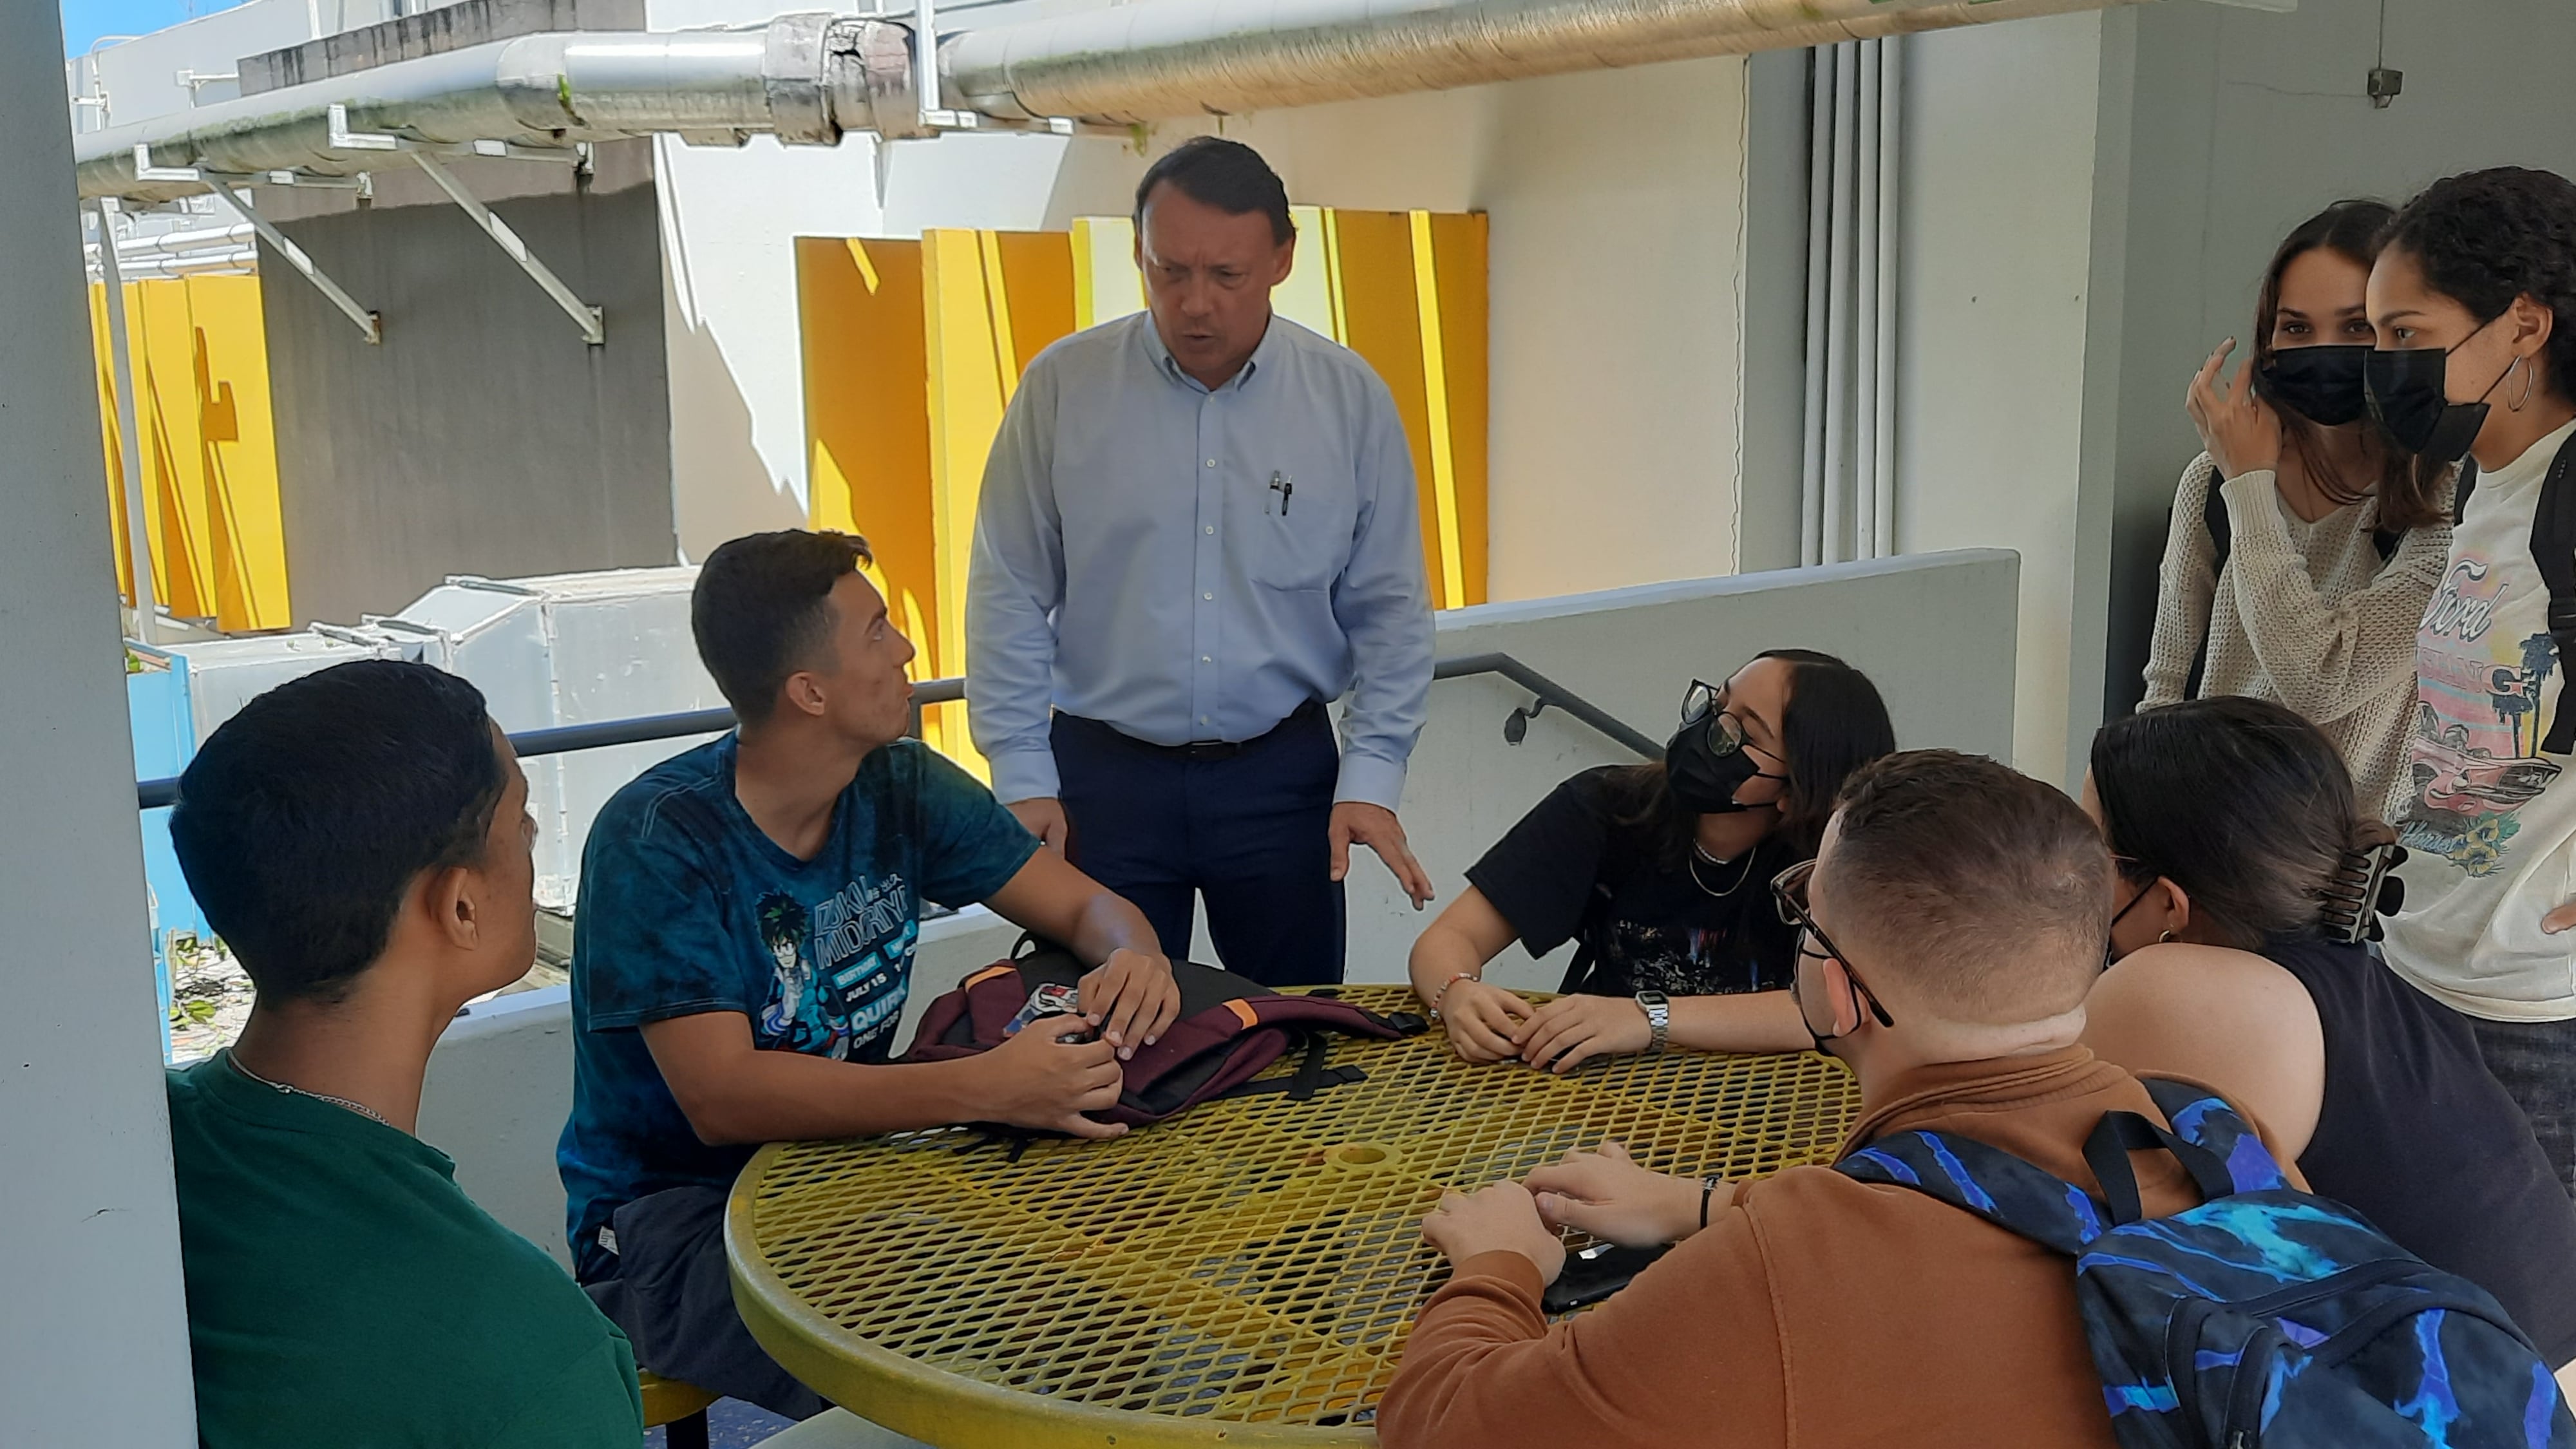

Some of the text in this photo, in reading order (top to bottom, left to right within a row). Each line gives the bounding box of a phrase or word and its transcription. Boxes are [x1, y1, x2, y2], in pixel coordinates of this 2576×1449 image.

[2419, 559, 2509, 642] Ford
[2417, 647, 2523, 696] STANG
[846, 973, 887, 1002] JULY 15
[853, 1010, 899, 1048] ONE FOR
